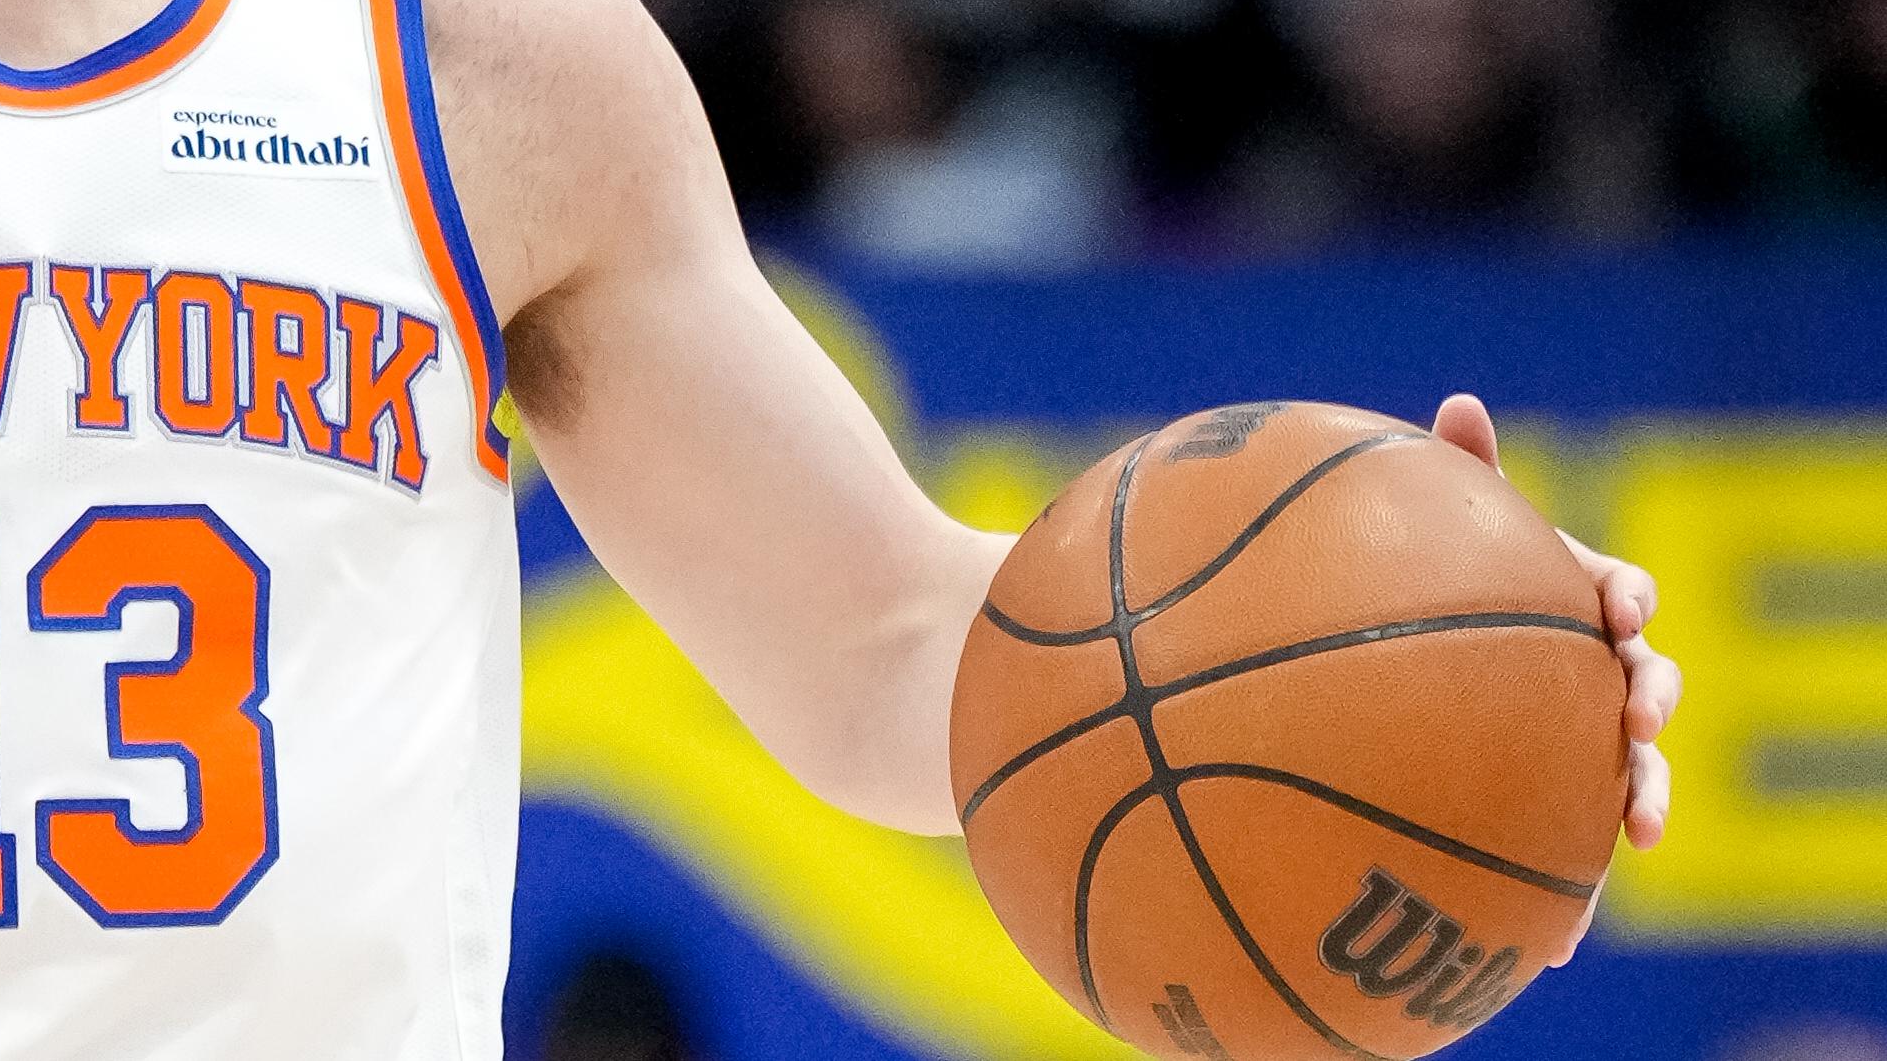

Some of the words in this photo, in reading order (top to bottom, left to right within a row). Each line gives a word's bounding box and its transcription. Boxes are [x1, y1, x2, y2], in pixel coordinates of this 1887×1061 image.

[170, 128, 248, 163] abu
[255, 134, 371, 168] dhabi
[172, 109, 279, 129] experience
[47, 262, 441, 494] YORK
[1317, 862, 1525, 1030] Wil
